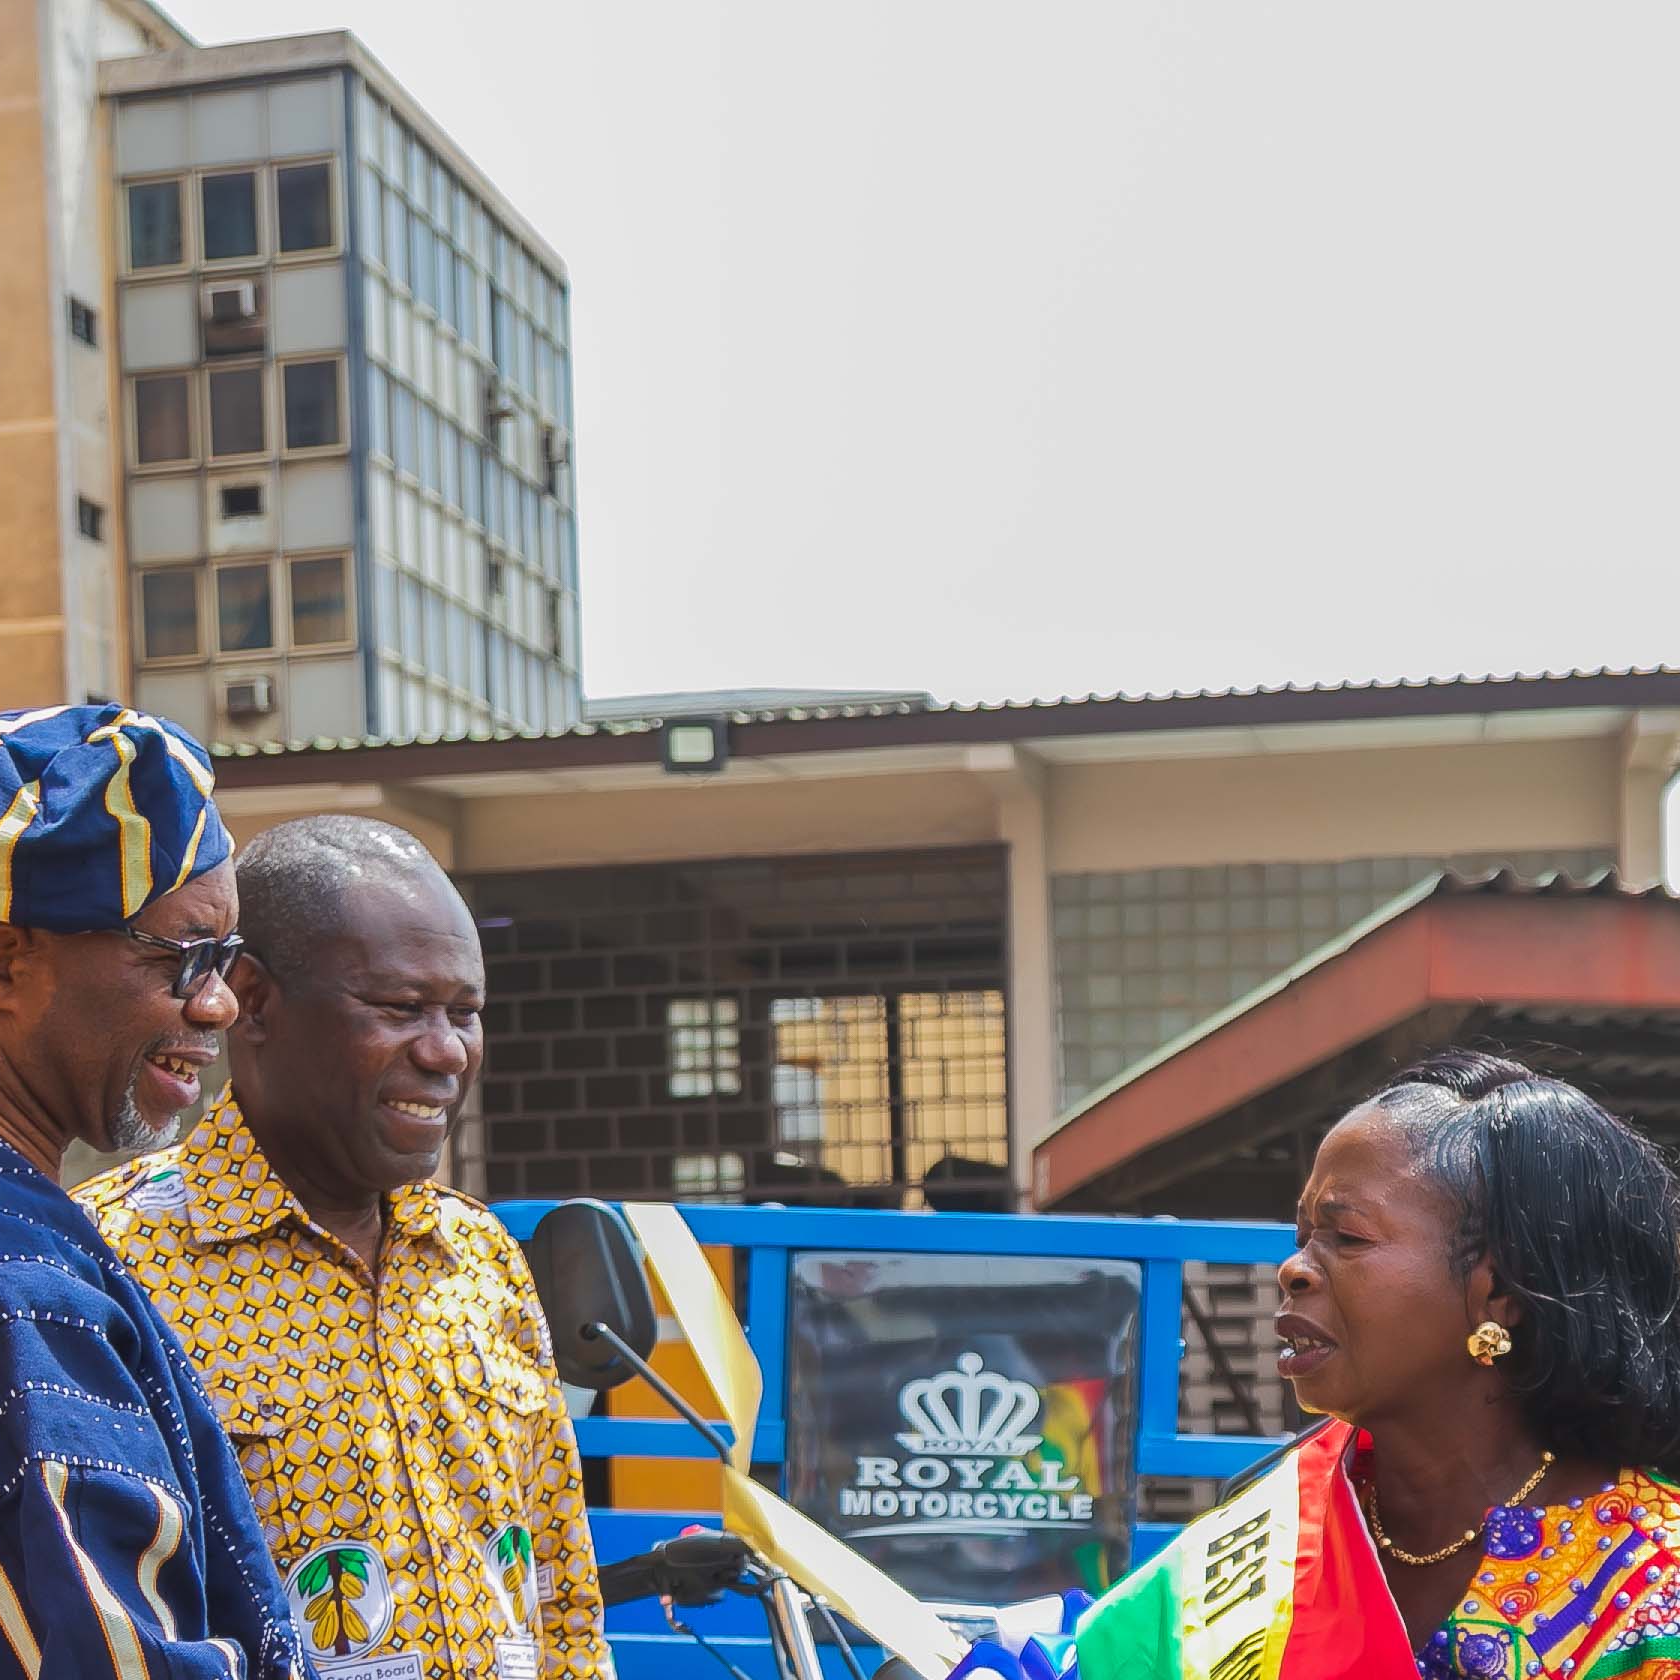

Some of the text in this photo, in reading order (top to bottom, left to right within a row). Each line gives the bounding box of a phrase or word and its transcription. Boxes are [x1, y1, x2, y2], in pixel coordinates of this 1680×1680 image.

[922, 1439, 1014, 1451] ROYAL
[856, 1456, 1080, 1491] ROYAL
[840, 1488, 1094, 1520] MOTORCYCLE
[1204, 1508, 1271, 1627] BEST
[376, 1662, 415, 1680] Board
